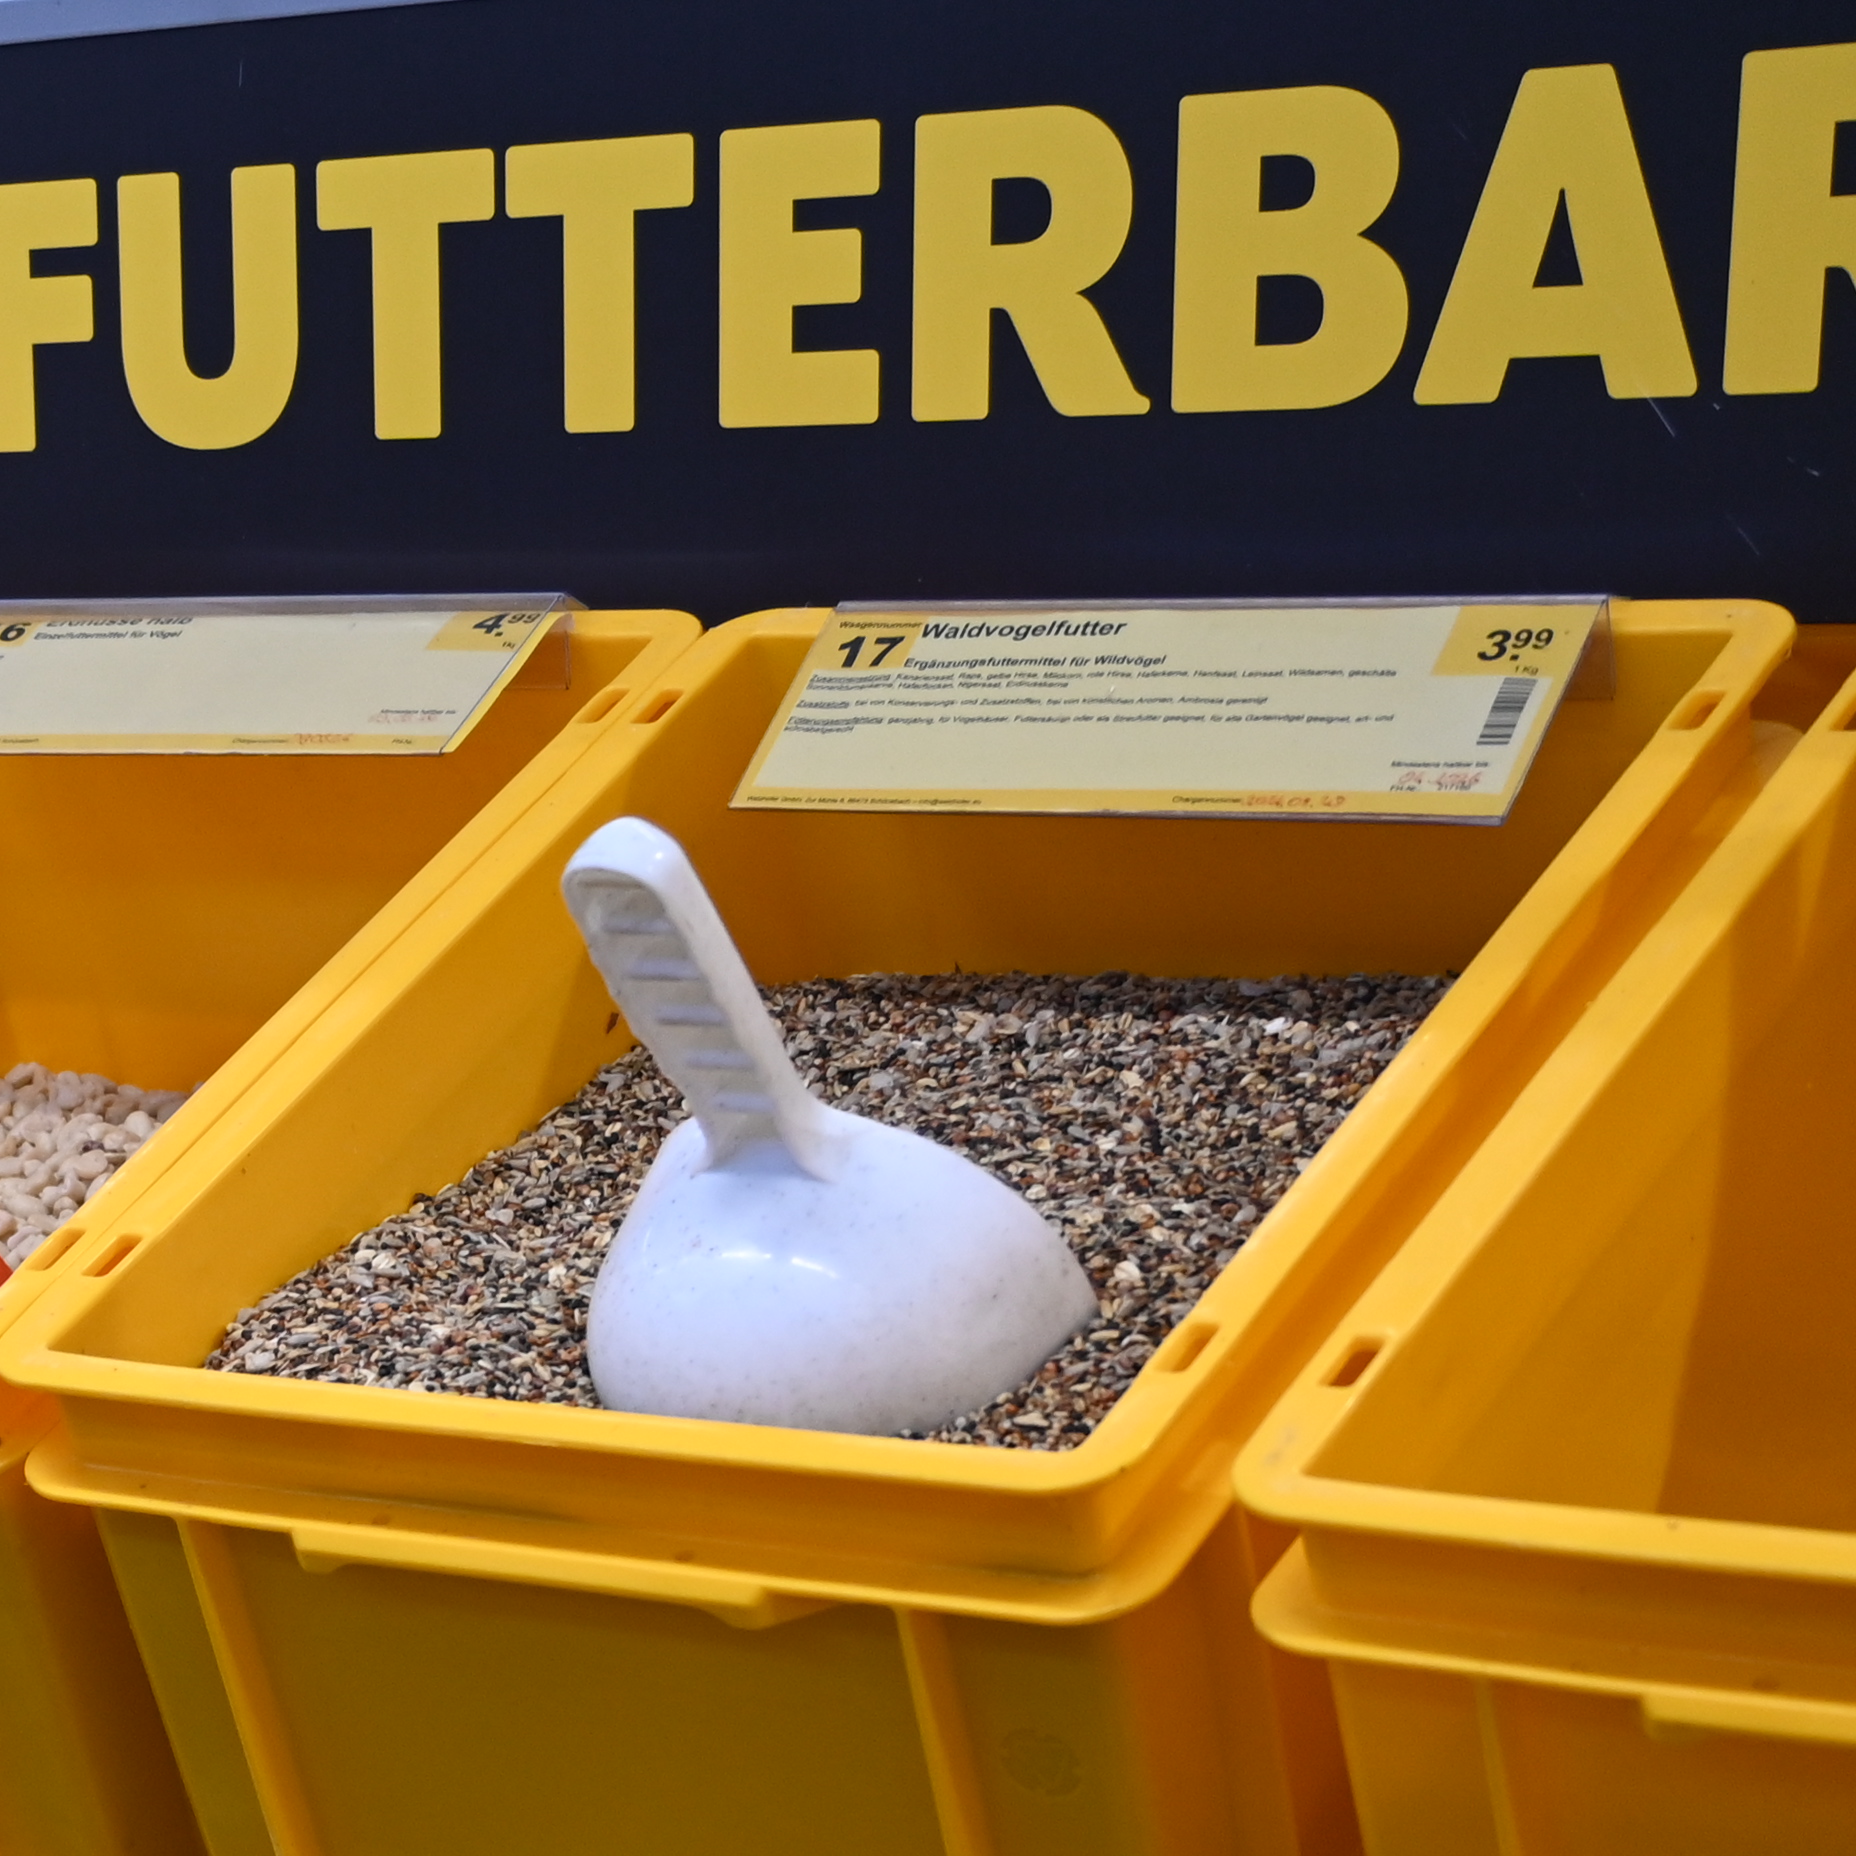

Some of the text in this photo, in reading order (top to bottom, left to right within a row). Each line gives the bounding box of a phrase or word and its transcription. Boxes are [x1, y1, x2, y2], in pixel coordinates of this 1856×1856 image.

[129, 630, 146, 638] für
[148, 629, 183, 640] Vögel
[472, 612, 541, 637] 4.99
[921, 620, 1127, 641] Waldvogelfutter
[838, 636, 906, 668] 17
[1477, 628, 1554, 662] 3.99
[904, 655, 1166, 670] Ergänzungsfuttermittel für Wildvögel
